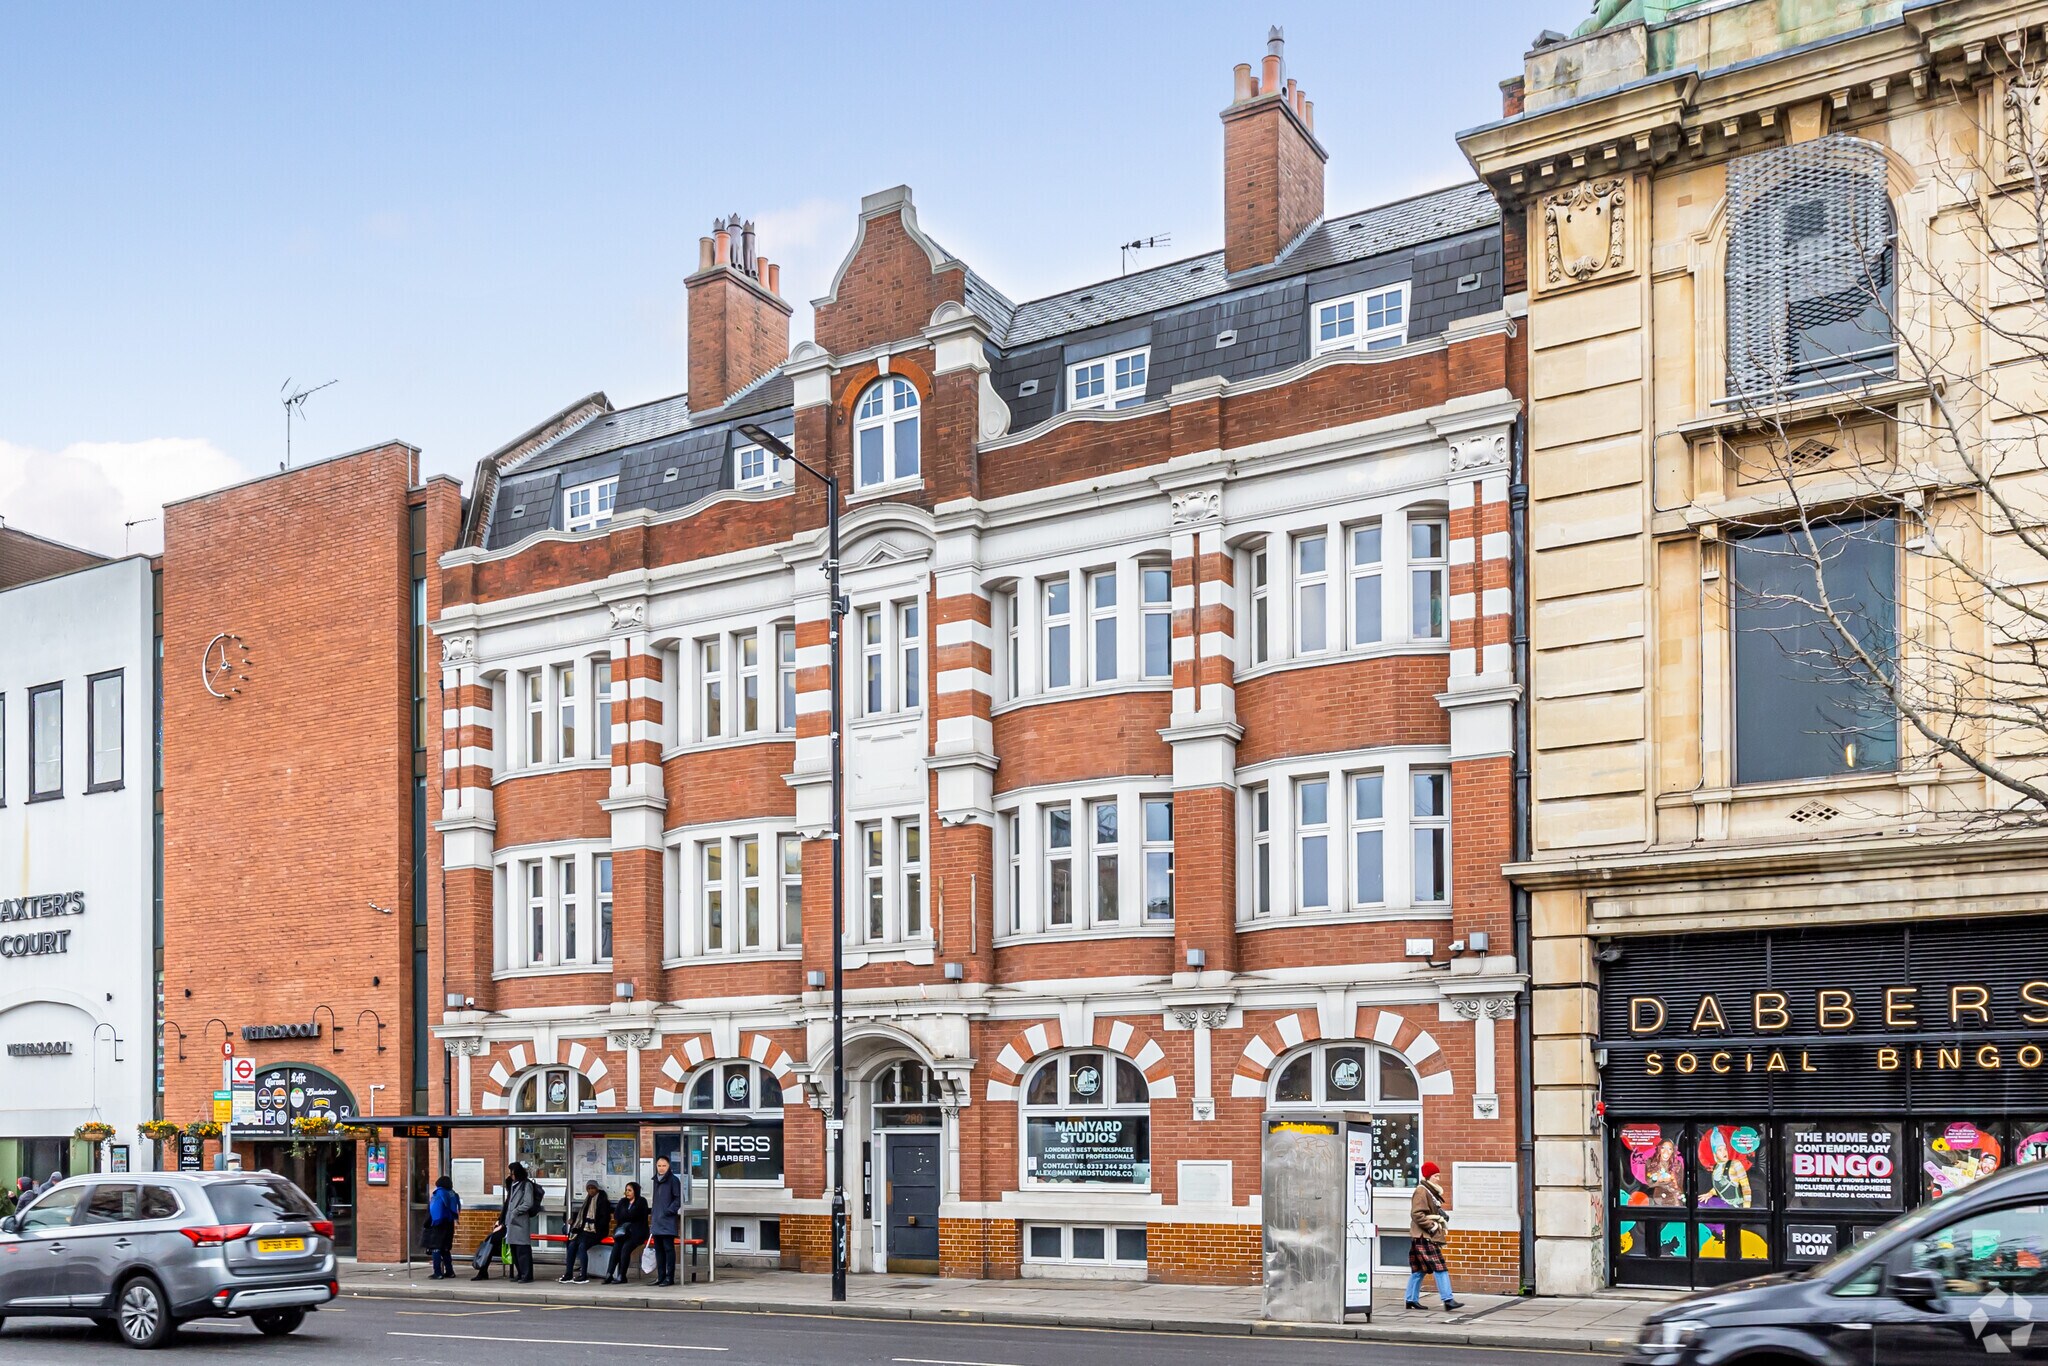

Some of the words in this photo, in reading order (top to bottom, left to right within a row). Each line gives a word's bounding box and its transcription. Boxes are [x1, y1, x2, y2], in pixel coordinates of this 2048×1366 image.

[0, 929, 71, 957] COURT
[1630, 981, 2048, 1033] DABBERS
[224, 1043, 232, 1054] B
[1646, 1051, 1818, 1076] SOCIAL
[1877, 1045, 2043, 1071] BINGO
[265, 1078, 286, 1088] Corona
[290, 1072, 307, 1085] Leffe
[305, 1087, 337, 1097] Budweiser
[904, 1113, 923, 1124] 280
[1055, 1121, 1122, 1132] MAINYARD
[1060, 1132, 1117, 1143] STUDIOS
[1794, 1132, 1822, 1142] THE
[1826, 1132, 1868, 1142] HOME
[1871, 1132, 1891, 1142] OF
[1794, 1144, 1891, 1153] CONTEMPORARY
[715, 1154, 756, 1162] BARBERS
[1793, 1154, 1893, 1177] BINGO
[1792, 1232, 1832, 1244] BOOK
[1796, 1244, 1829, 1255] NOW
